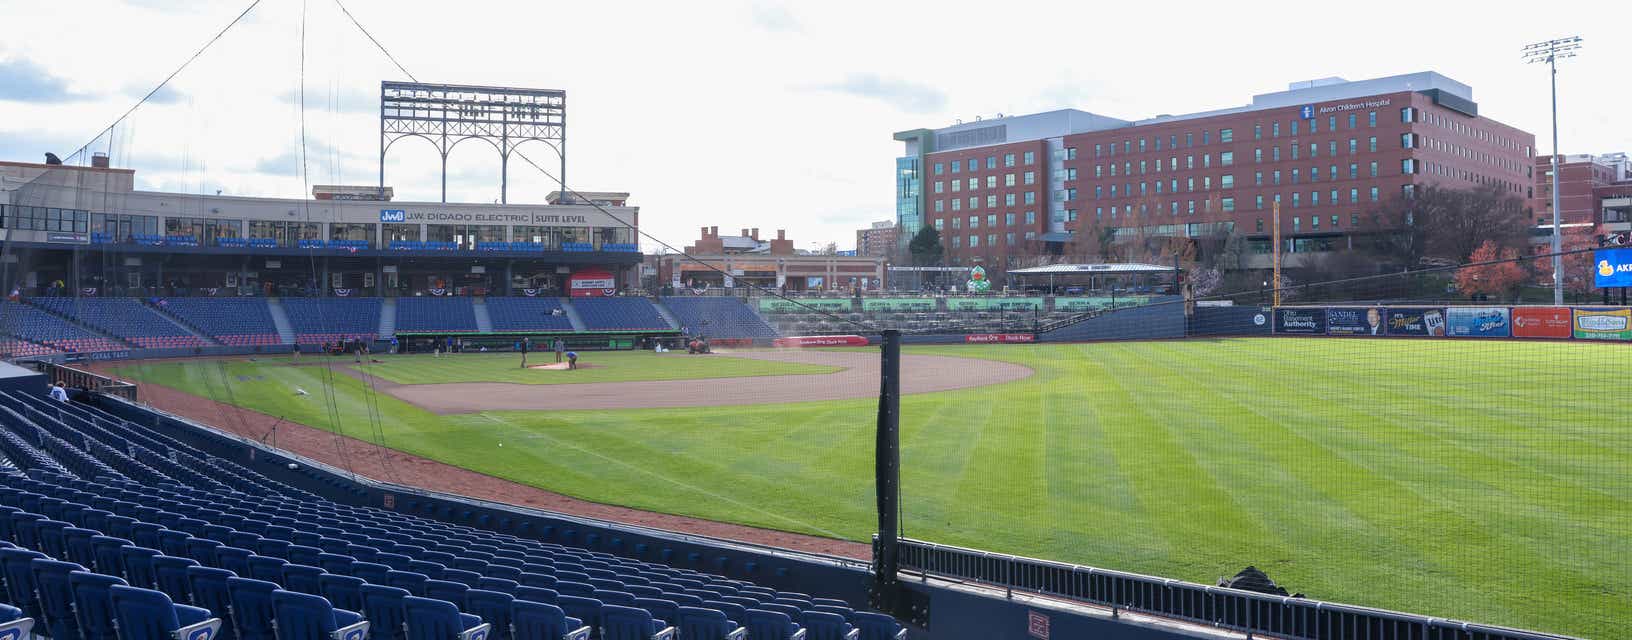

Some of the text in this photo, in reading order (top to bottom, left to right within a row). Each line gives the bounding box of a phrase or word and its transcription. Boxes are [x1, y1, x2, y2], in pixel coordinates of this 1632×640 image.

[1337, 102, 1365, 111] Children's
[1366, 99, 1390, 108] Hospital
[427, 213, 472, 221] DIDADO
[475, 214, 529, 222] ELECTRIC
[535, 215, 560, 223] SUITE
[1283, 320, 1316, 328] Authority
